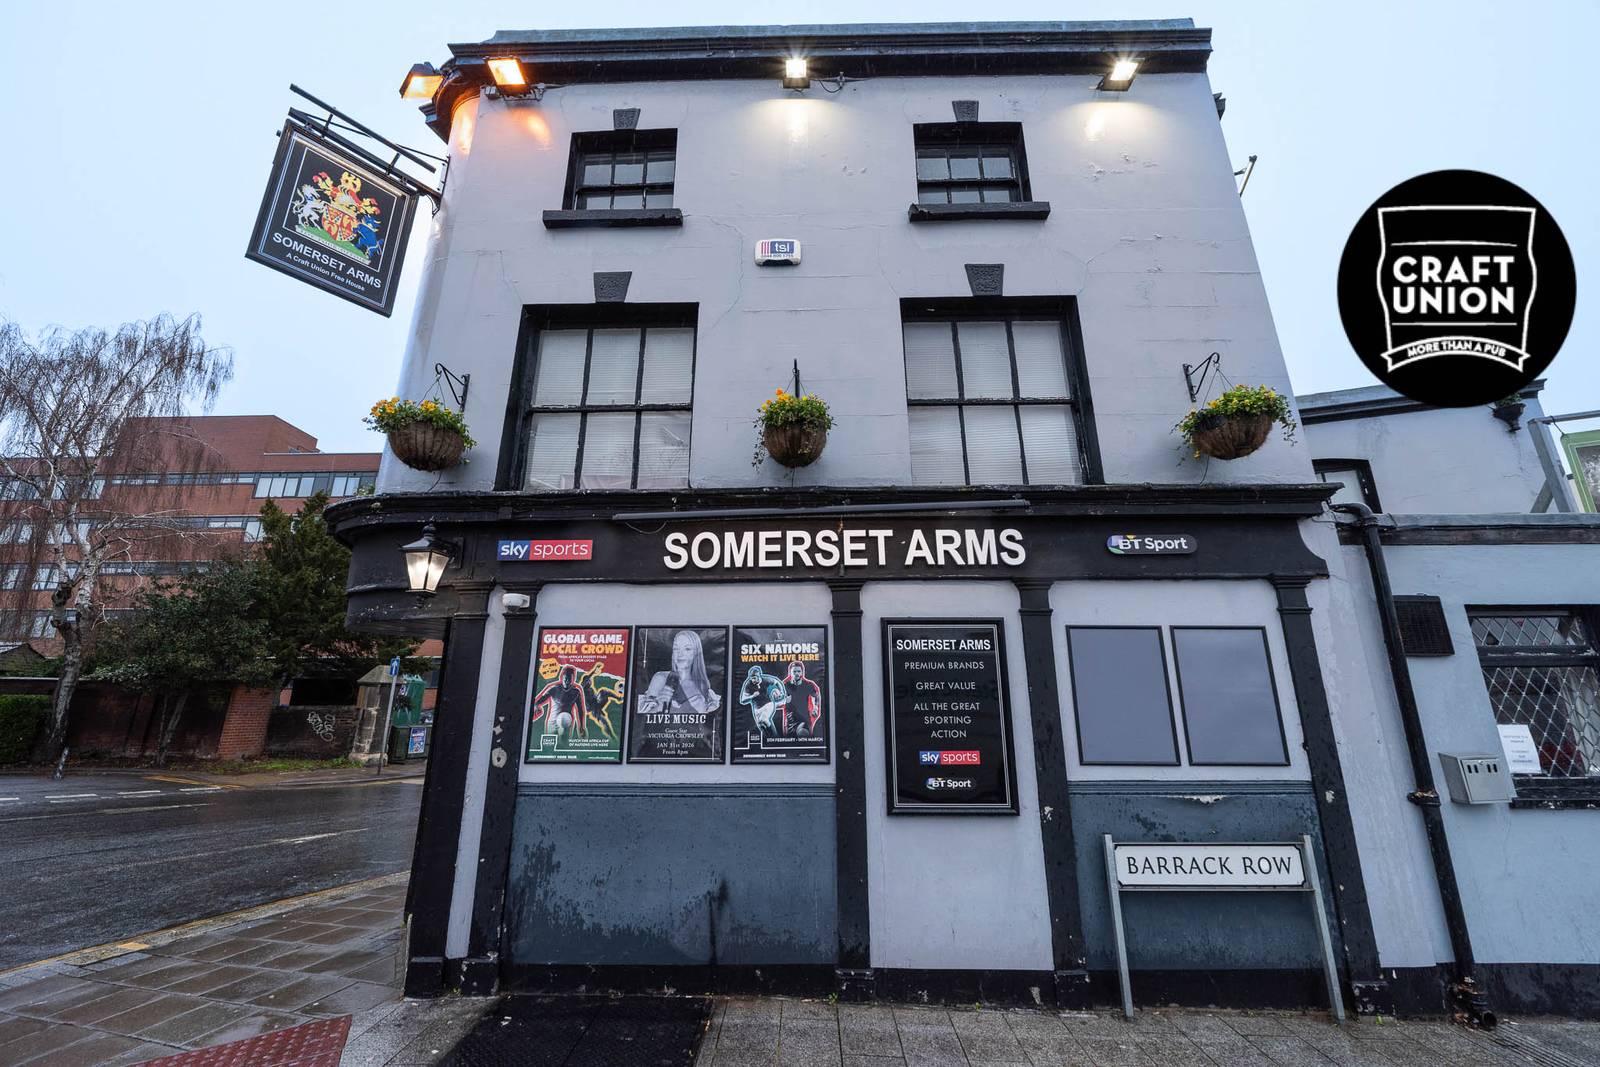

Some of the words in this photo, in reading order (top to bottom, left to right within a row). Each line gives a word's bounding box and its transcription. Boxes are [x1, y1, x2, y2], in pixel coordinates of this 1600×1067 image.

[272, 232, 346, 272] SOMERSET
[346, 266, 382, 288] ARMS
[293, 255, 310, 267] Craft
[310, 262, 330, 276] Union
[330, 271, 345, 282] Free
[346, 278, 365, 291] House
[663, 529, 894, 570] SOMERSET
[904, 528, 1027, 566] ARMS
[1118, 538, 1144, 550] BT
[1144, 537, 1189, 552] Sport
[500, 543, 528, 560] sky
[533, 542, 589, 560] sports
[544, 634, 587, 644] GLOBAL
[590, 634, 625, 645] GAME,
[896, 639, 957, 650] SOMERSET
[959, 639, 991, 650] ARMS
[542, 644, 578, 654] LOCAL
[580, 644, 624, 654] CROWD
[740, 644, 762, 655] SIX
[765, 643, 819, 654] NATIONS
[770, 654, 778, 662] IT
[780, 654, 796, 662] LIVE
[904, 661, 945, 670] PREMIUM
[948, 661, 985, 670] BRANDS
[915, 681, 945, 690] GREAT
[947, 681, 976, 690] VALUE
[913, 702, 929, 711] ALL
[931, 702, 948, 711] THE
[950, 702, 980, 711] GREAT
[646, 714, 670, 724] LIVE
[672, 714, 706, 724] MUSIC
[924, 716, 972, 725] SPORTING
[930, 729, 967, 738] ACTION
[921, 752, 939, 765] sky
[943, 752, 978, 764] sports
[932, 780, 946, 788] BT
[947, 779, 971, 790] Sport
[1126, 856, 1234, 875] BARRACK
[1242, 856, 1292, 875] ROW
